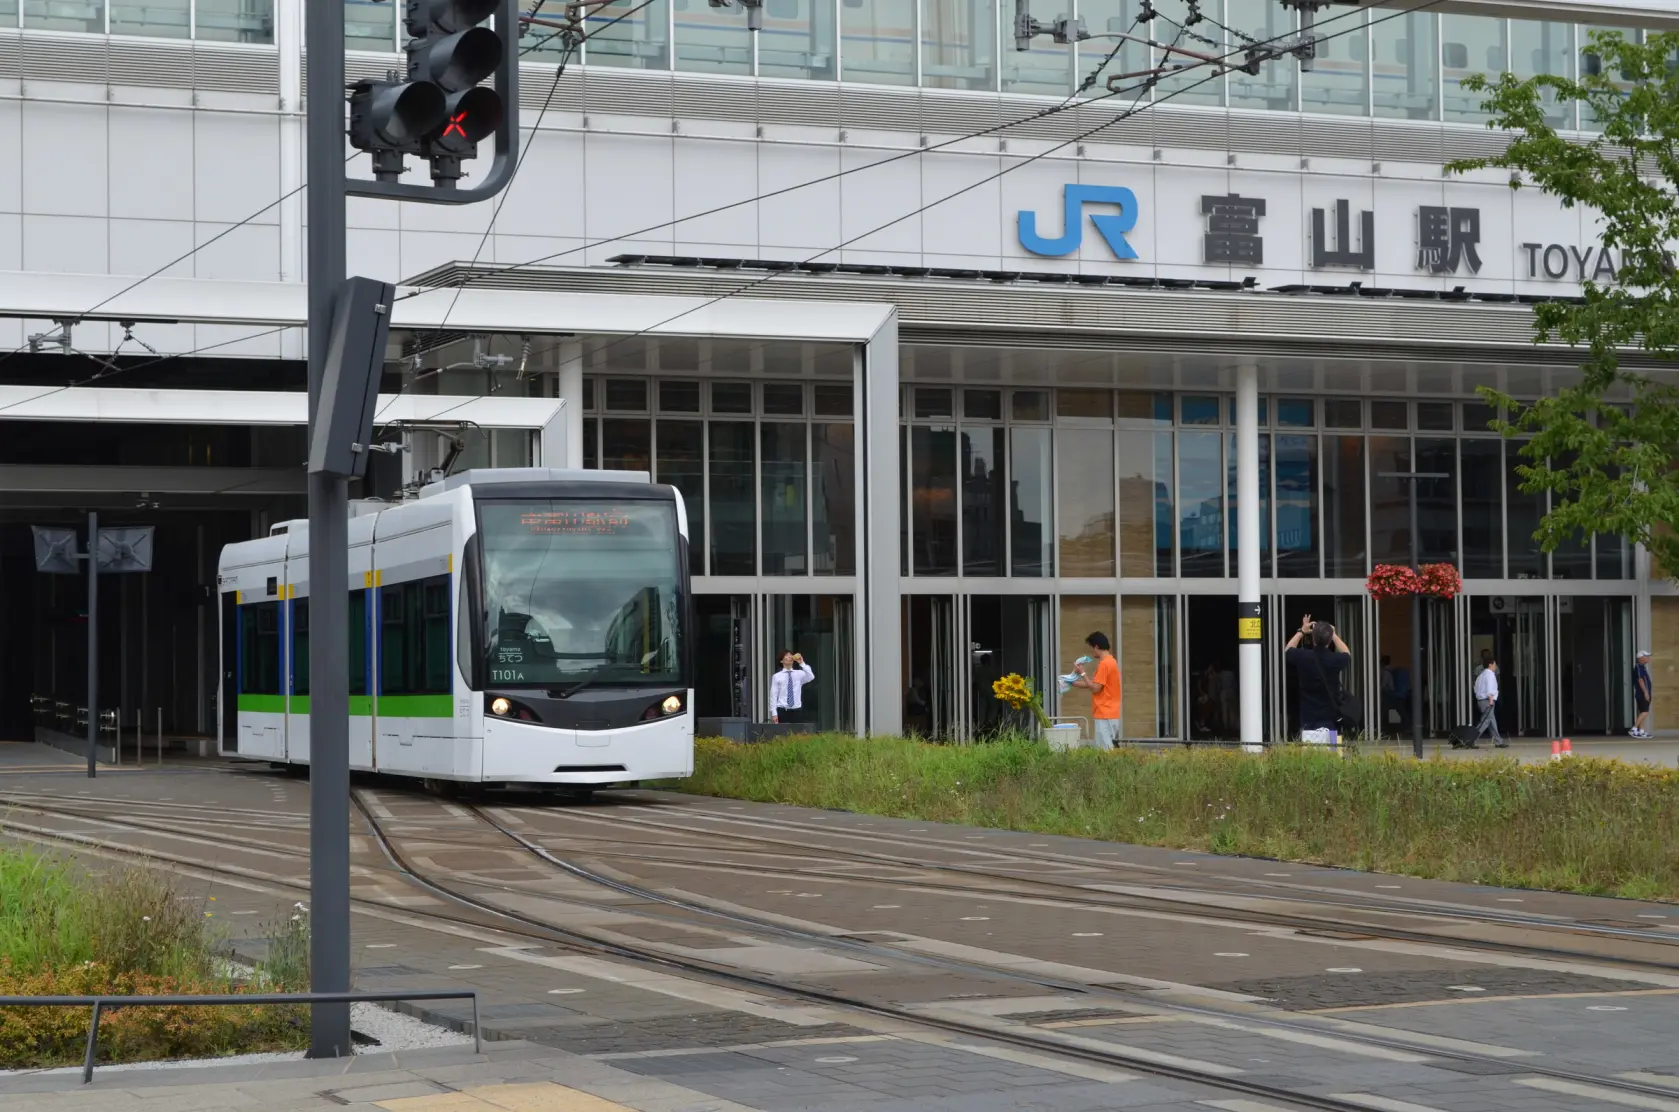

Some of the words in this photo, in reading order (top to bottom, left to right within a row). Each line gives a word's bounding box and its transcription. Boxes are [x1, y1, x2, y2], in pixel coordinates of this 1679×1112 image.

[1018, 184, 1139, 260] JR
[1200, 193, 1482, 274] 富山駅
[498, 654, 523, 663] ちてつ
[492, 669, 525, 681] T101A
